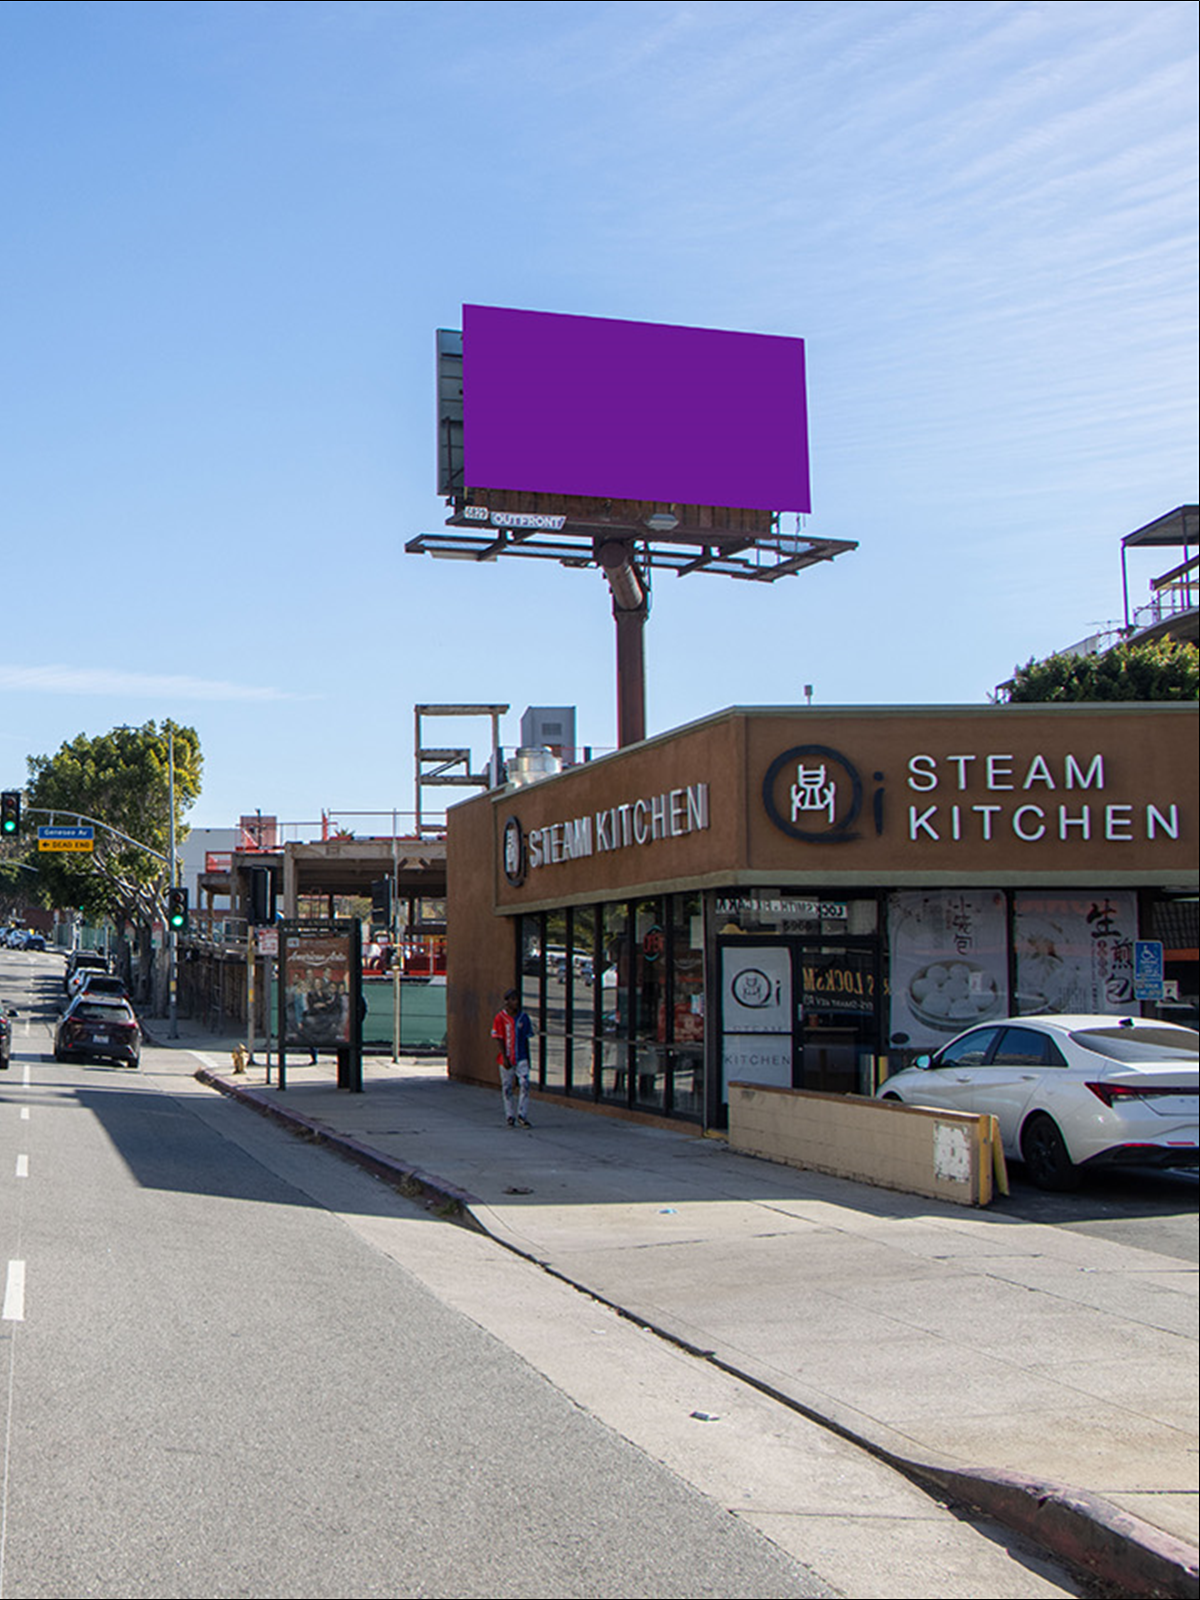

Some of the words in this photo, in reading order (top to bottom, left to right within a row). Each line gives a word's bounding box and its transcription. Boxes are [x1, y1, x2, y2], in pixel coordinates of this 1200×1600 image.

[494, 513, 563, 528] OUTFRONT
[907, 754, 1105, 791] STEAM
[528, 816, 593, 869] STEAM
[596, 782, 710, 852] KITCHEN
[909, 804, 1180, 841] KITCHEN
[724, 1054, 791, 1066] KITCHEN
